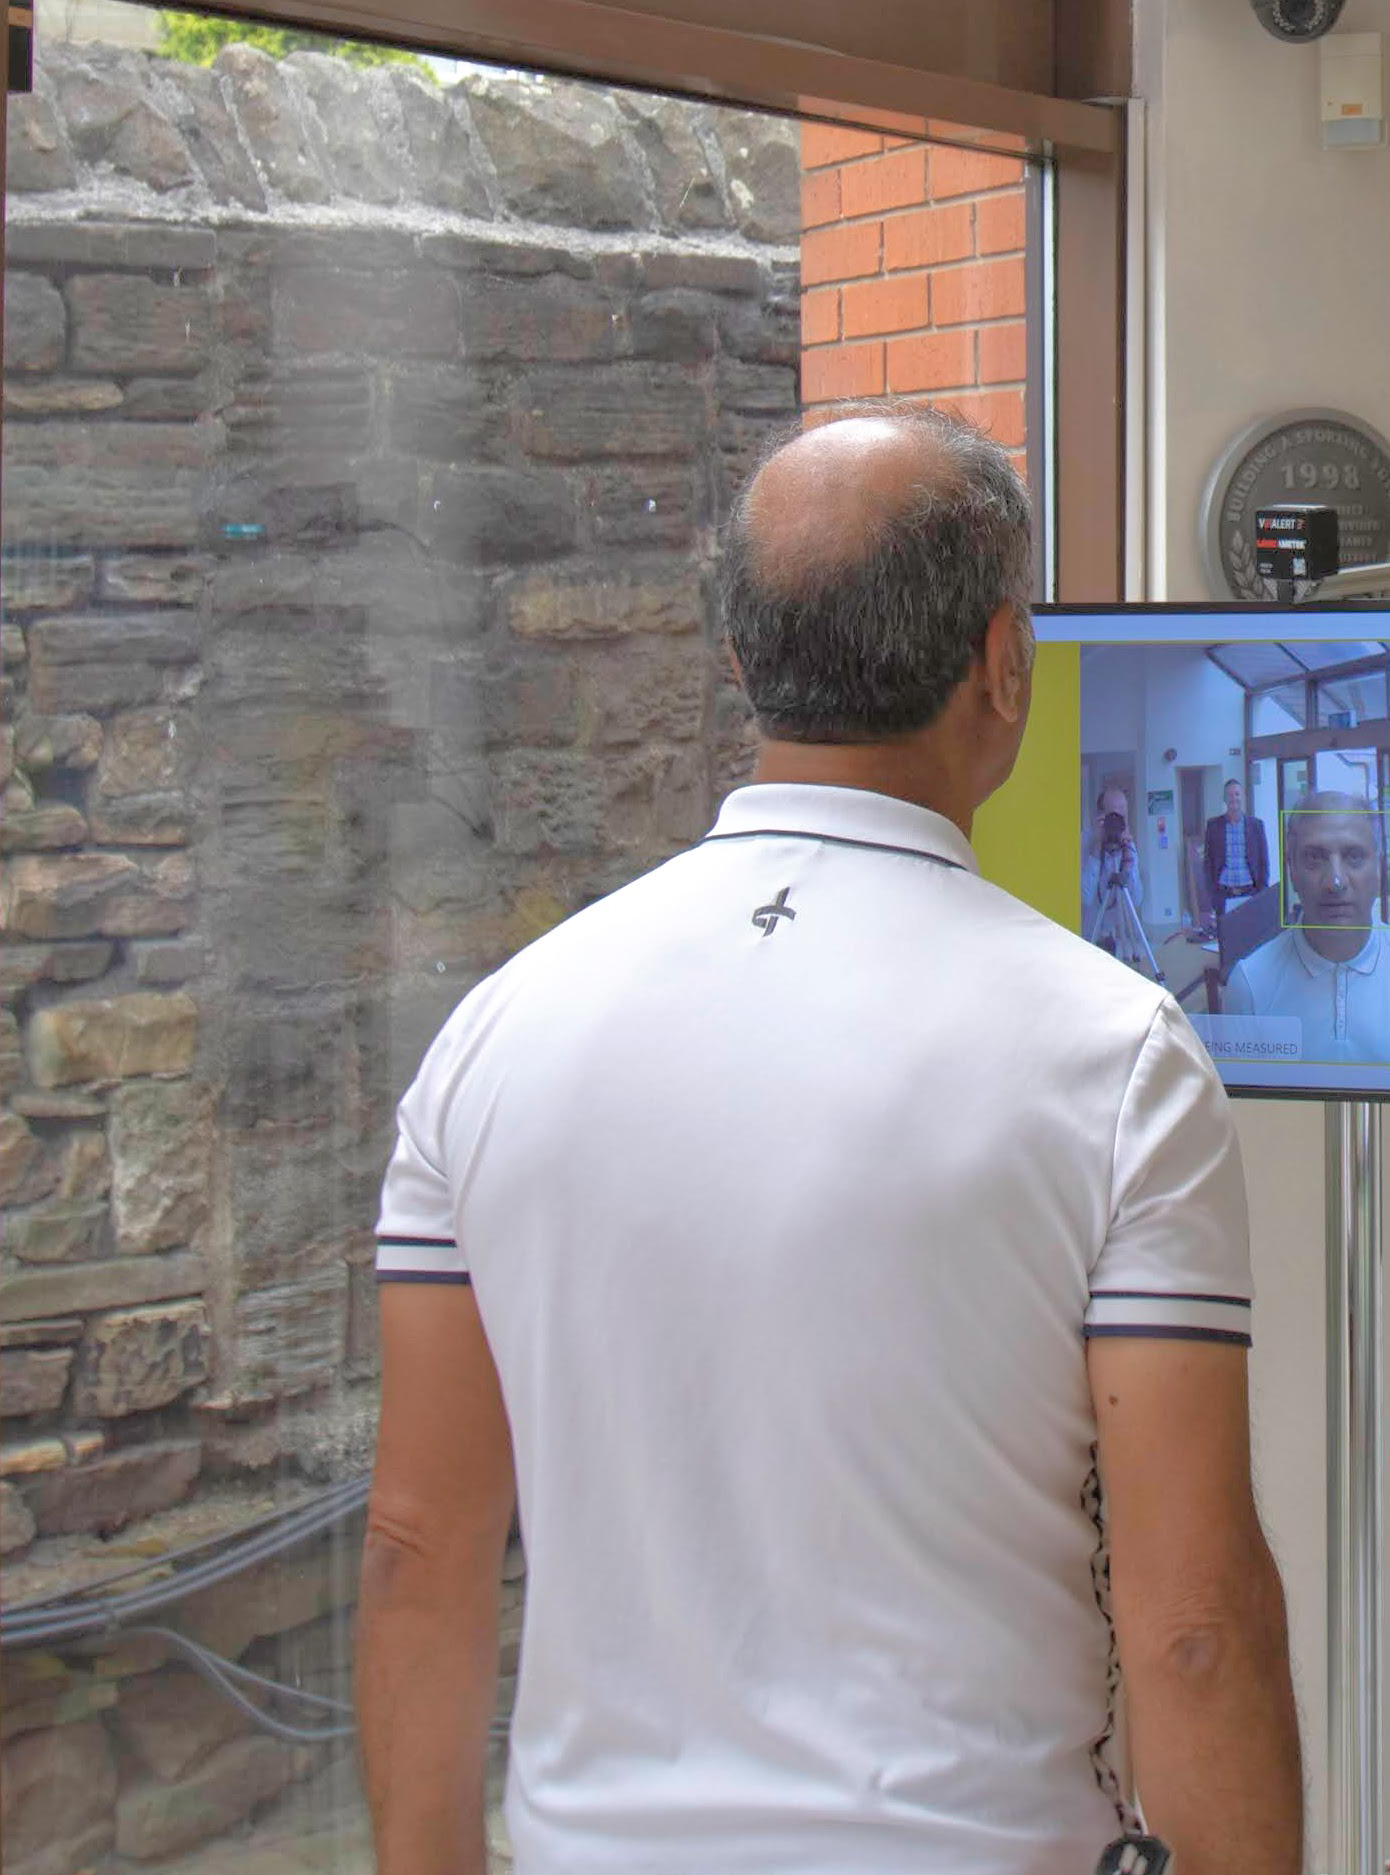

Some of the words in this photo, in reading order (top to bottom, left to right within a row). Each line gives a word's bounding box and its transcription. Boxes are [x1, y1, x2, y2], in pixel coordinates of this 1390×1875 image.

[1227, 442, 1278, 523] BUILDING
[1280, 433, 1292, 451] A
[1281, 461, 1361, 490] 1998
[1235, 1042, 1299, 1055] MEASURED
